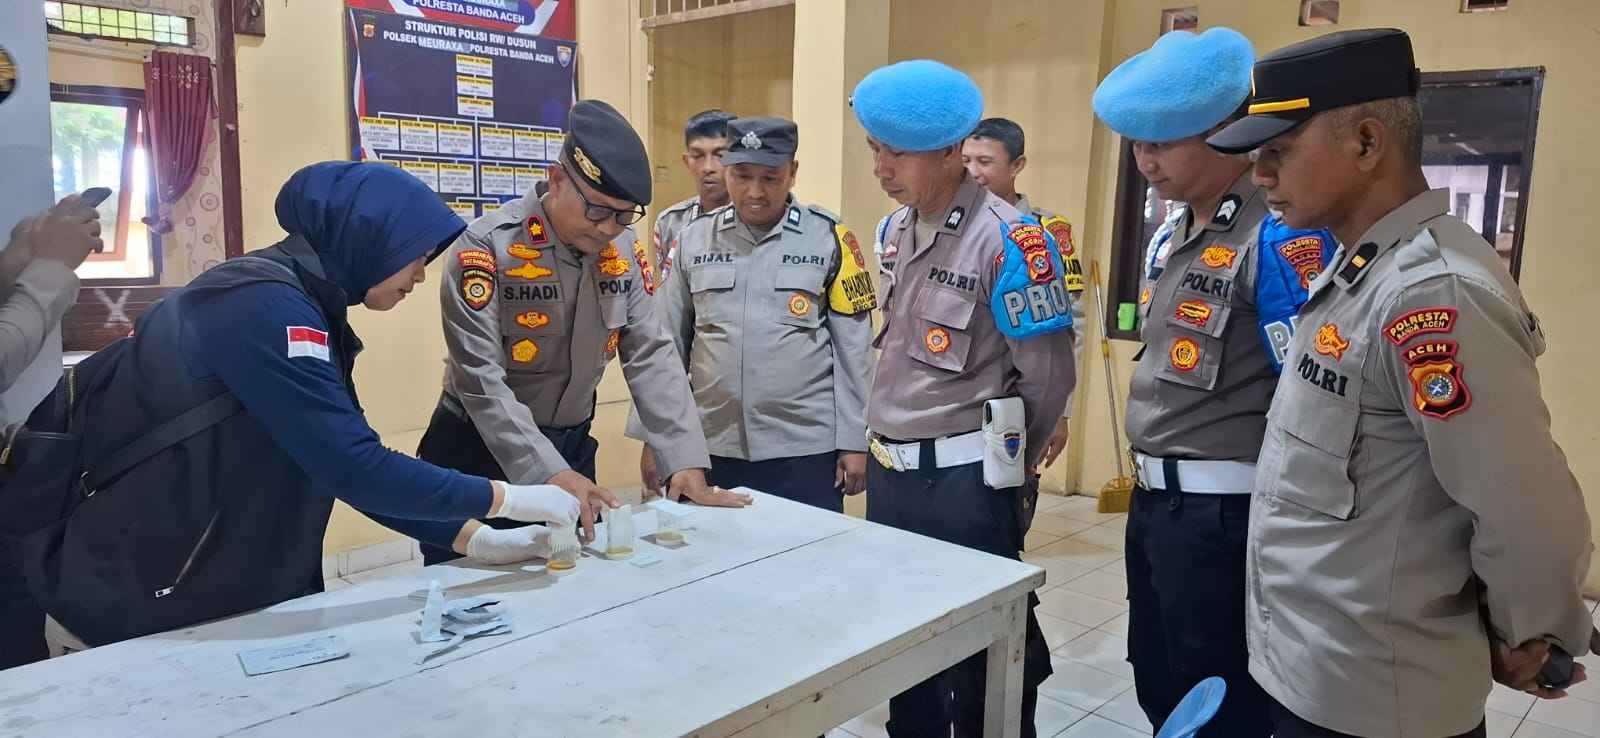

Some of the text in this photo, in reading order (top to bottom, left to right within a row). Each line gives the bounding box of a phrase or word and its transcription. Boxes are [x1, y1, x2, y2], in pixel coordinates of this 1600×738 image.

[413, 0, 525, 24] POLRESTA BANDA ACEH
[405, 20, 457, 37] STRUKTUR
[458, 29, 488, 43] POLISI
[507, 36, 537, 50] DUSUN
[383, 30, 555, 65] POLSEK MEURAXA POLRESTA BANDA ACEH
[693, 253, 734, 265] RIJAL
[782, 254, 825, 266] POLRI
[928, 267, 976, 292] POLRI
[1181, 272, 1231, 299] POLRI
[503, 284, 558, 301] S.HADI
[1389, 312, 1449, 337] POLRESTA
[1422, 320, 1445, 329] ACEH
[1408, 343, 1447, 359] ACEH
[1298, 353, 1350, 397] POLRI
